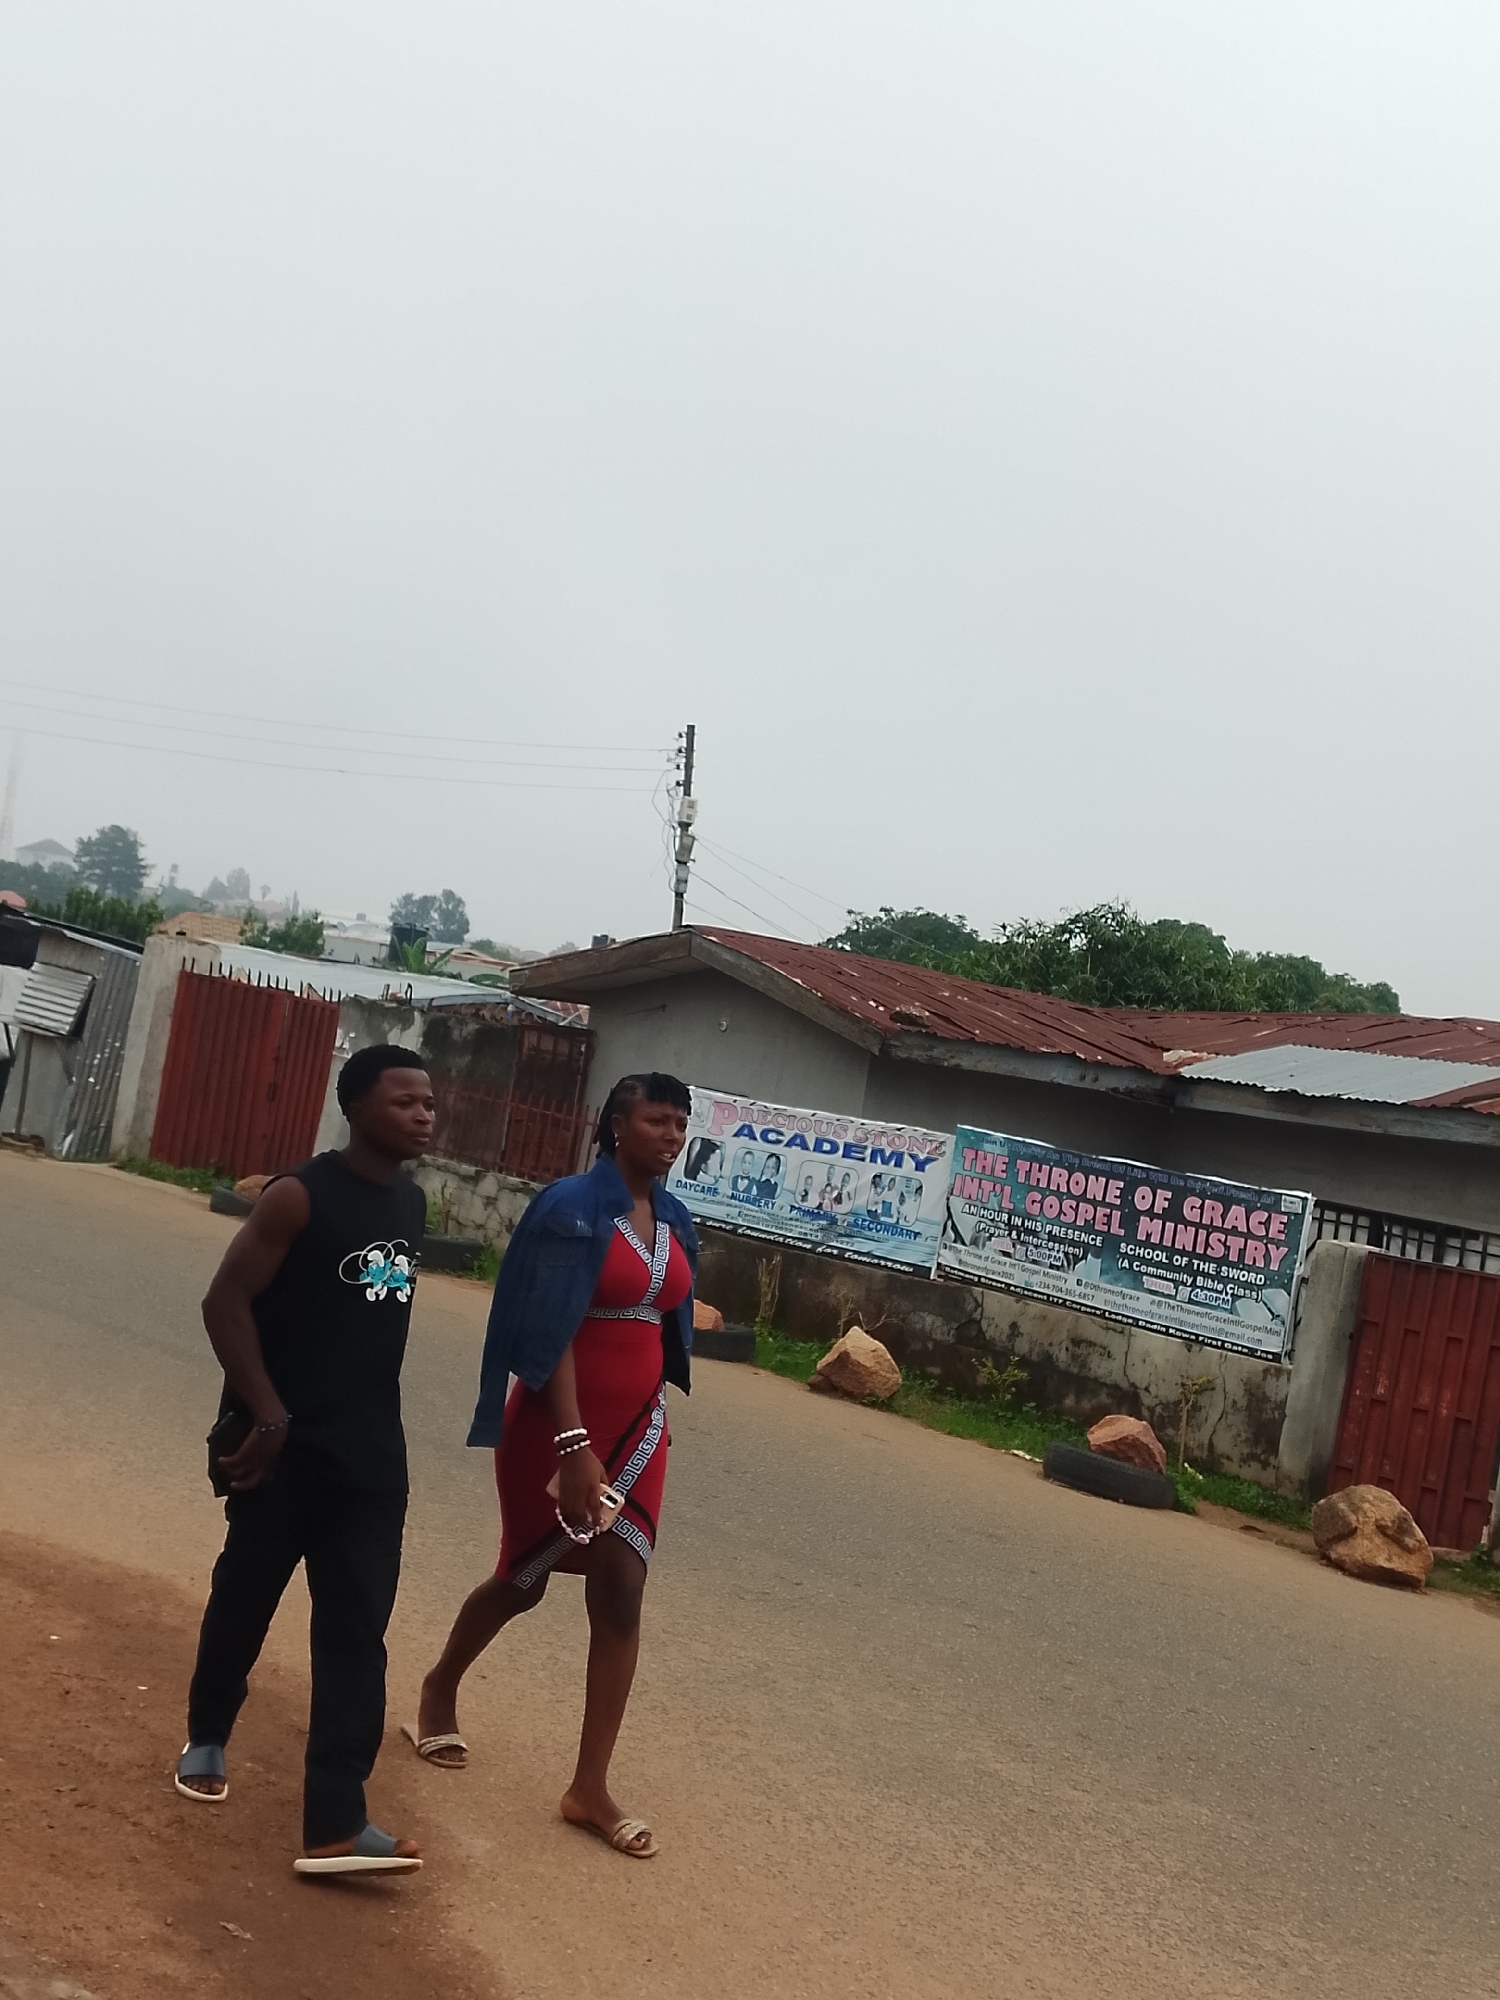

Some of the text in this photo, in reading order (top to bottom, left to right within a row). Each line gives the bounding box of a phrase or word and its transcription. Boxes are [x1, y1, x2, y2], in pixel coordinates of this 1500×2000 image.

[707, 1100, 849, 1139] PRECIOUS
[853, 1127, 947, 1157] STONE
[731, 1123, 939, 1173] ACADEMY
[675, 1180, 718, 1198] DAYCARE
[853, 1218, 921, 1241] SECONDARY
[962, 1147, 1010, 1179] THE
[1016, 1158, 1125, 1206] THRONE
[1133, 1186, 1173, 1214] OF
[1183, 1195, 1289, 1241] GRACE
[952, 1173, 1290, 1272] INT'L GOSPEL MINISTRY
[962, 1203, 1104, 1248] AN HOUR IN HIS PRESENCE
[976, 1221, 1084, 1258] (Prayer & Intercession)
[736, 1226, 813, 1250] foundation
[815, 1243, 839, 1255] for
[844, 1250, 914, 1273] tomorrow
[963, 1248, 983, 1262] Throne
[983, 1253, 991, 1263] of
[990, 1255, 1007, 1268] Grace
[1021, 1262, 1042, 1278] Gospel
[1043, 1270, 1069, 1285] Ministry
[1027, 1247, 1062, 1265] 5:00PM
[1119, 1242, 1266, 1286] SCHOOL OF THE SWORD
[1118, 1257, 1263, 1303] (A Community Bible Class)
[1191, 1289, 1231, 1308] 4:30PM
[1010, 1285, 1048, 1301] Adjacent
[1198, 1335, 1223, 1349] First
